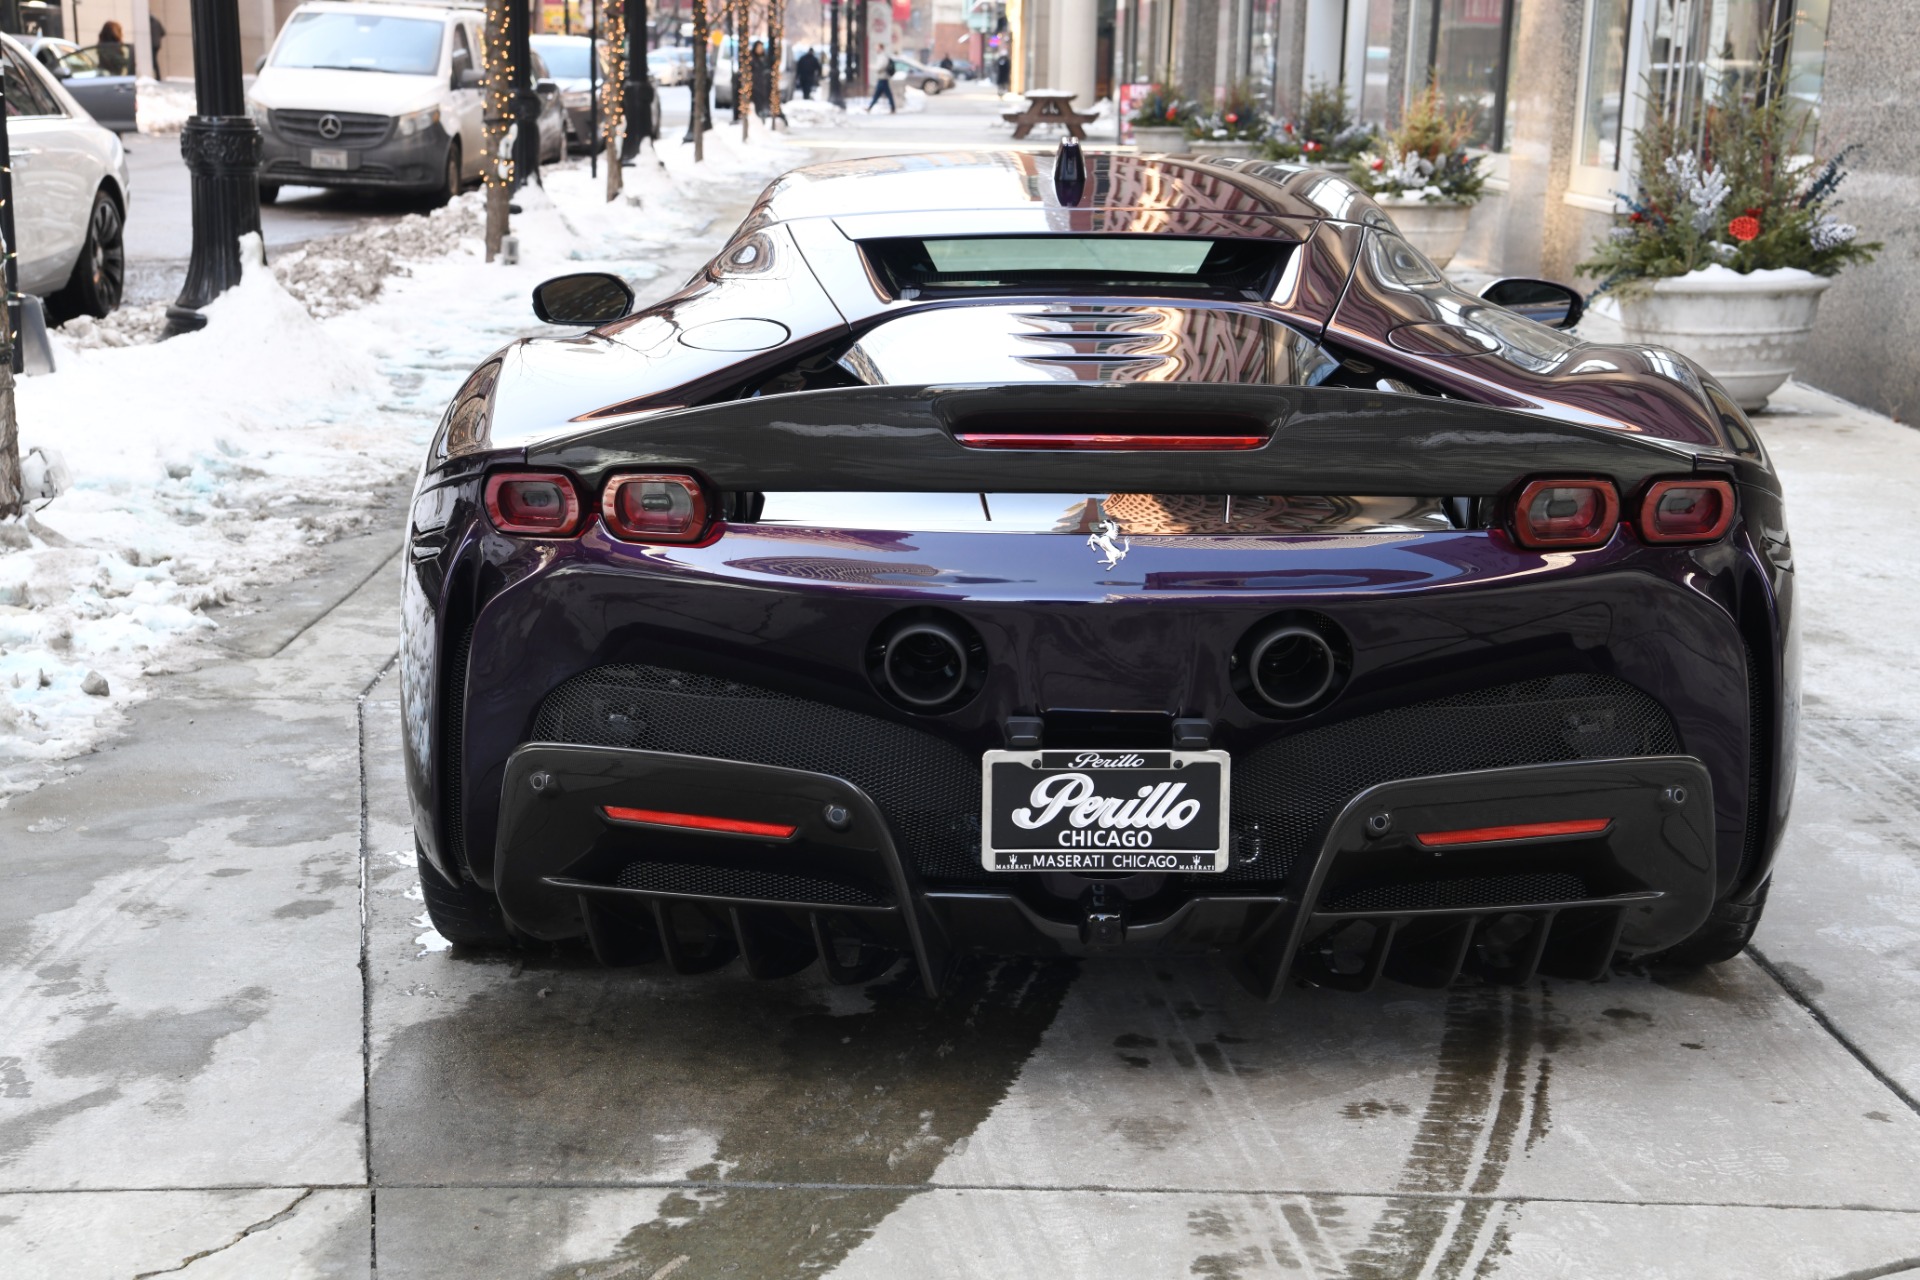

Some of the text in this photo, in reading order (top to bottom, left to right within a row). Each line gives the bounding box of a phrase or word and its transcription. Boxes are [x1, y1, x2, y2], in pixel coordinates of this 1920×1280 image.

[1068, 752, 1144, 769] Perillo
[1011, 772, 1200, 830] Perillo
[1058, 830, 1153, 848] CHICAGO
[1032, 855, 1178, 869] MASERATI CHICAGO
